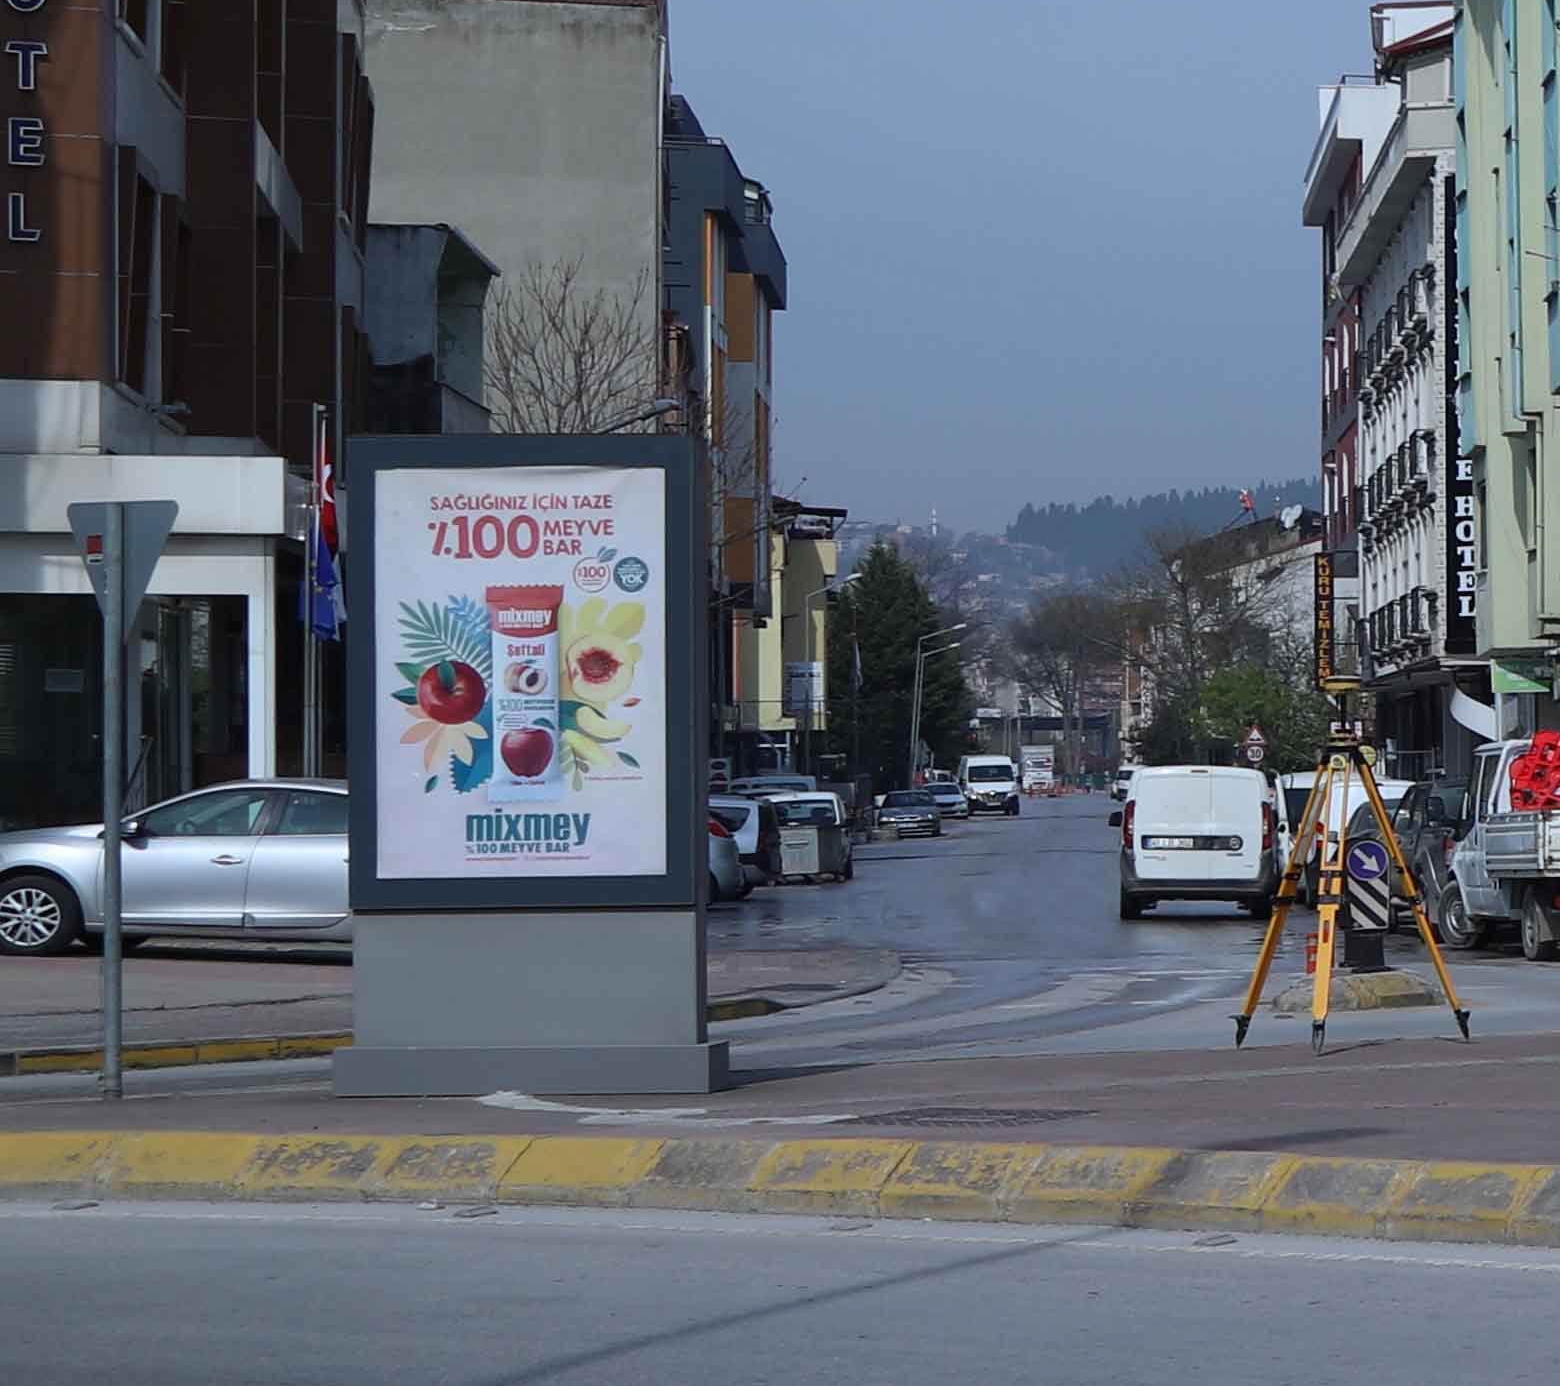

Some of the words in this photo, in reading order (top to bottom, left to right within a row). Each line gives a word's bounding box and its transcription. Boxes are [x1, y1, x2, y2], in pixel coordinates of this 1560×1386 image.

[430, 494, 527, 511] SAĞLIĞINIZ
[533, 493, 567, 512] İÇİN
[572, 494, 612, 510] TAZE
[543, 519, 614, 536] MEYVE
[543, 540, 582, 556] BAR
[466, 808, 592, 845] mixmey
[500, 842, 541, 853] MEYVE
[545, 842, 570, 853] BAR
